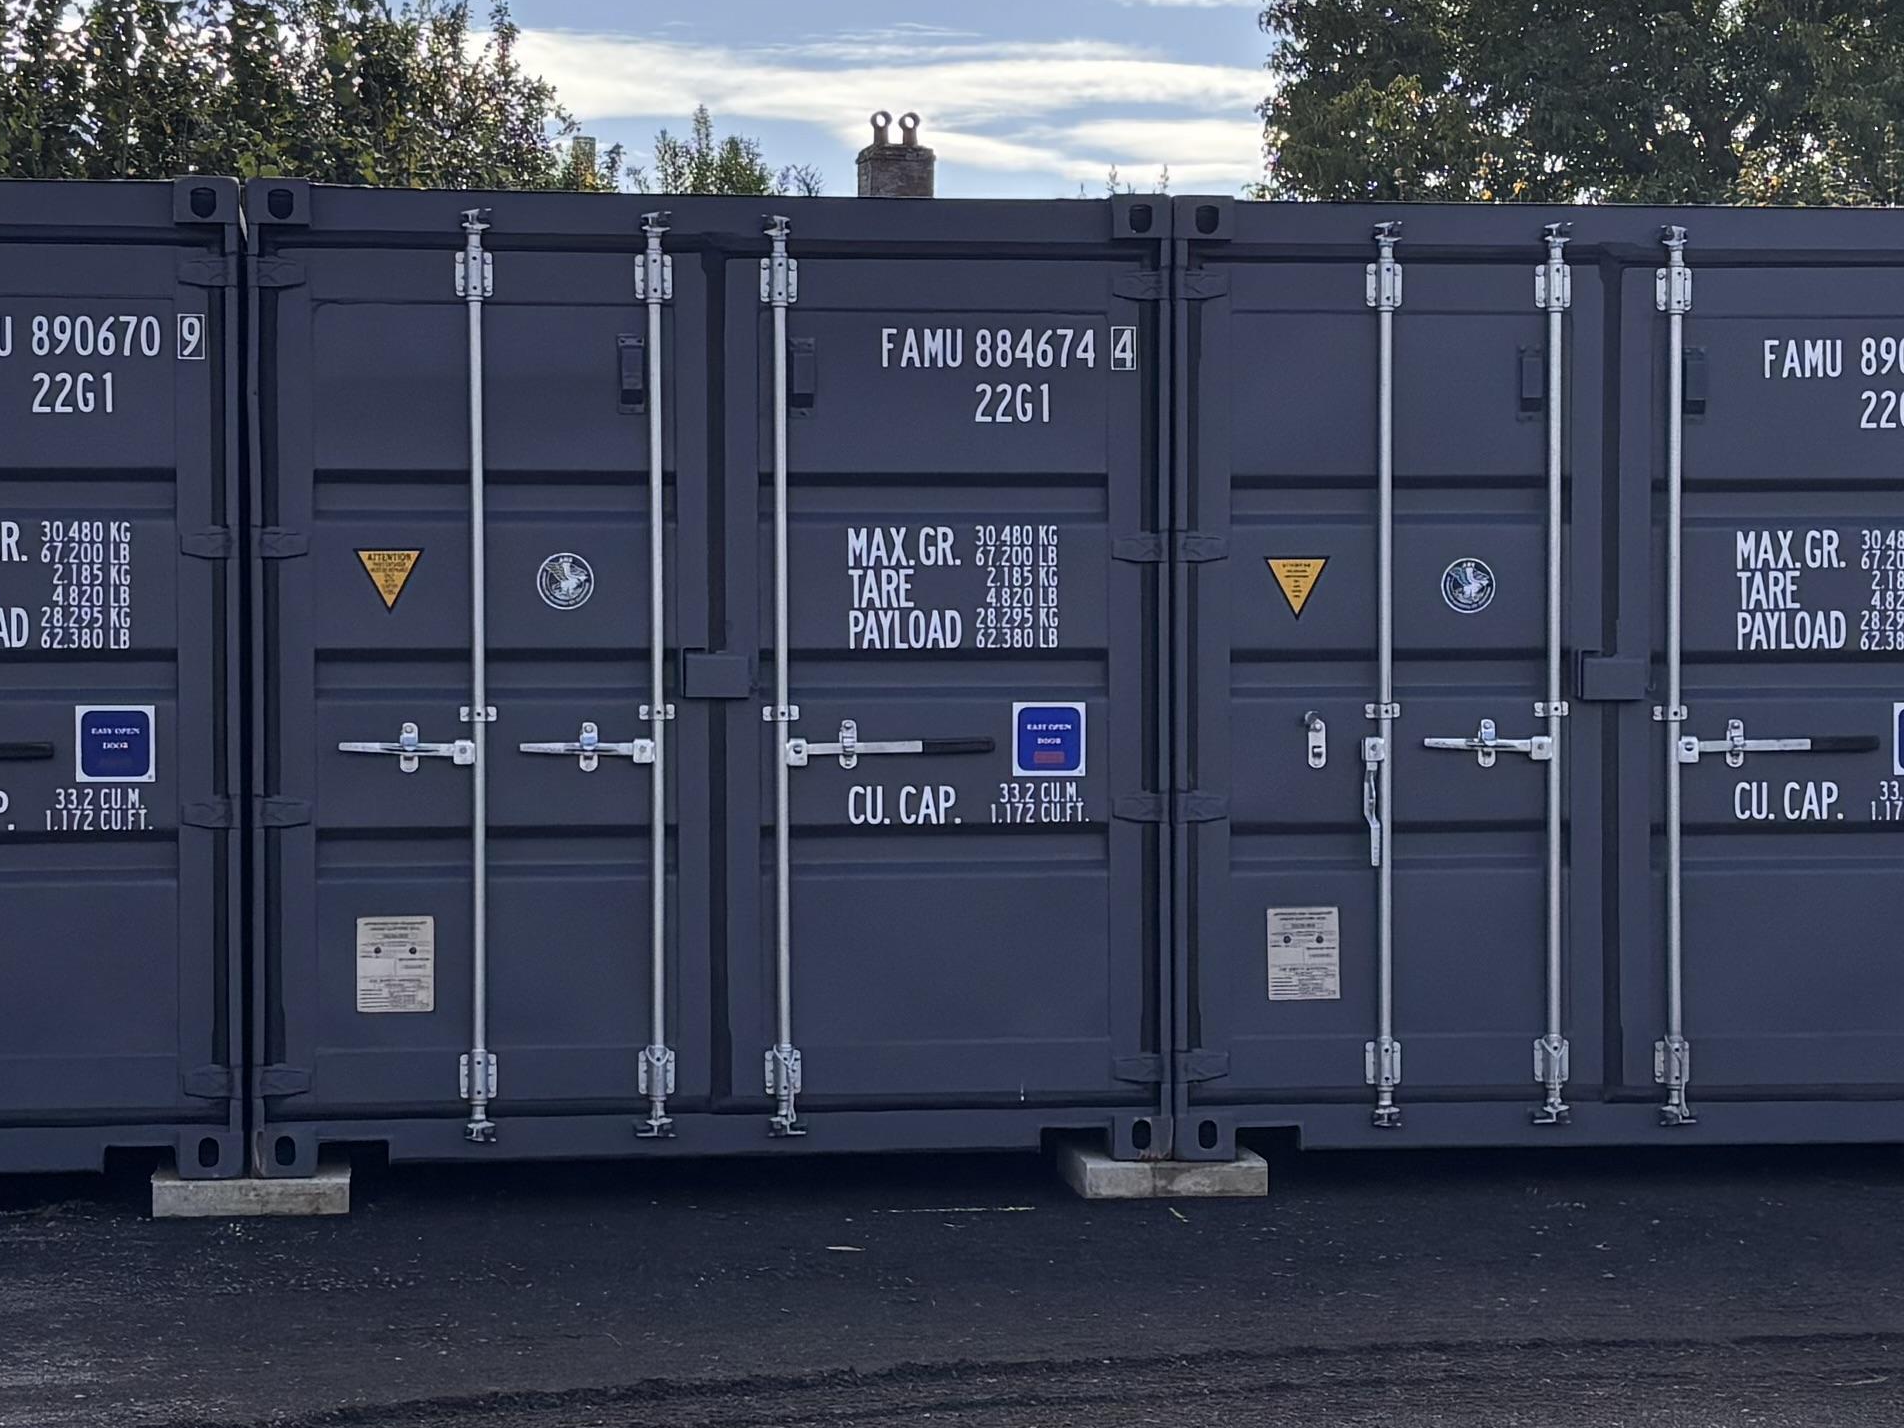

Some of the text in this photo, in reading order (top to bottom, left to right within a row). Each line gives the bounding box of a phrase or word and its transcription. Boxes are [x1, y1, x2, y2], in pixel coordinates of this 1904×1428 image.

[32, 316, 160, 356] 890670
[182, 317, 201, 356] 9
[882, 328, 1133, 367] FAMU 884674 4
[1764, 340, 1842, 378] FAMU
[32, 372, 113, 413] 22G1
[975, 384, 1049, 422] 22G1
[110, 522, 131, 542] KG
[1039, 525, 1057, 545] KG
[110, 543, 130, 563] LB
[1039, 547, 1057, 566] LB
[52, 564, 131, 584] 2.185 KG
[987, 567, 1057, 587] 2.185 KG
[110, 586, 130, 606] LB
[848, 569, 914, 608] TARE
[1039, 588, 1057, 607] LB
[1737, 571, 1801, 610] TARE
[110, 608, 131, 627] KG
[1039, 609, 1058, 628] KG
[110, 629, 130, 649] LB
[849, 610, 962, 649] PAYLOAD
[1039, 629, 1058, 648] LB
[1737, 611, 1846, 650] PAYLOAD
[115, 727, 140, 735] OPEN
[56, 789, 145, 809] 33.2 CU.M.
[1000, 782, 1081, 803] 33.2 CU.M.
[1734, 782, 1844, 820] CU. CAP.
[848, 786, 961, 824] CU. CAP.
[1041, 803, 1089, 822] CU.FT.
[101, 810, 153, 830] CU.FT.
